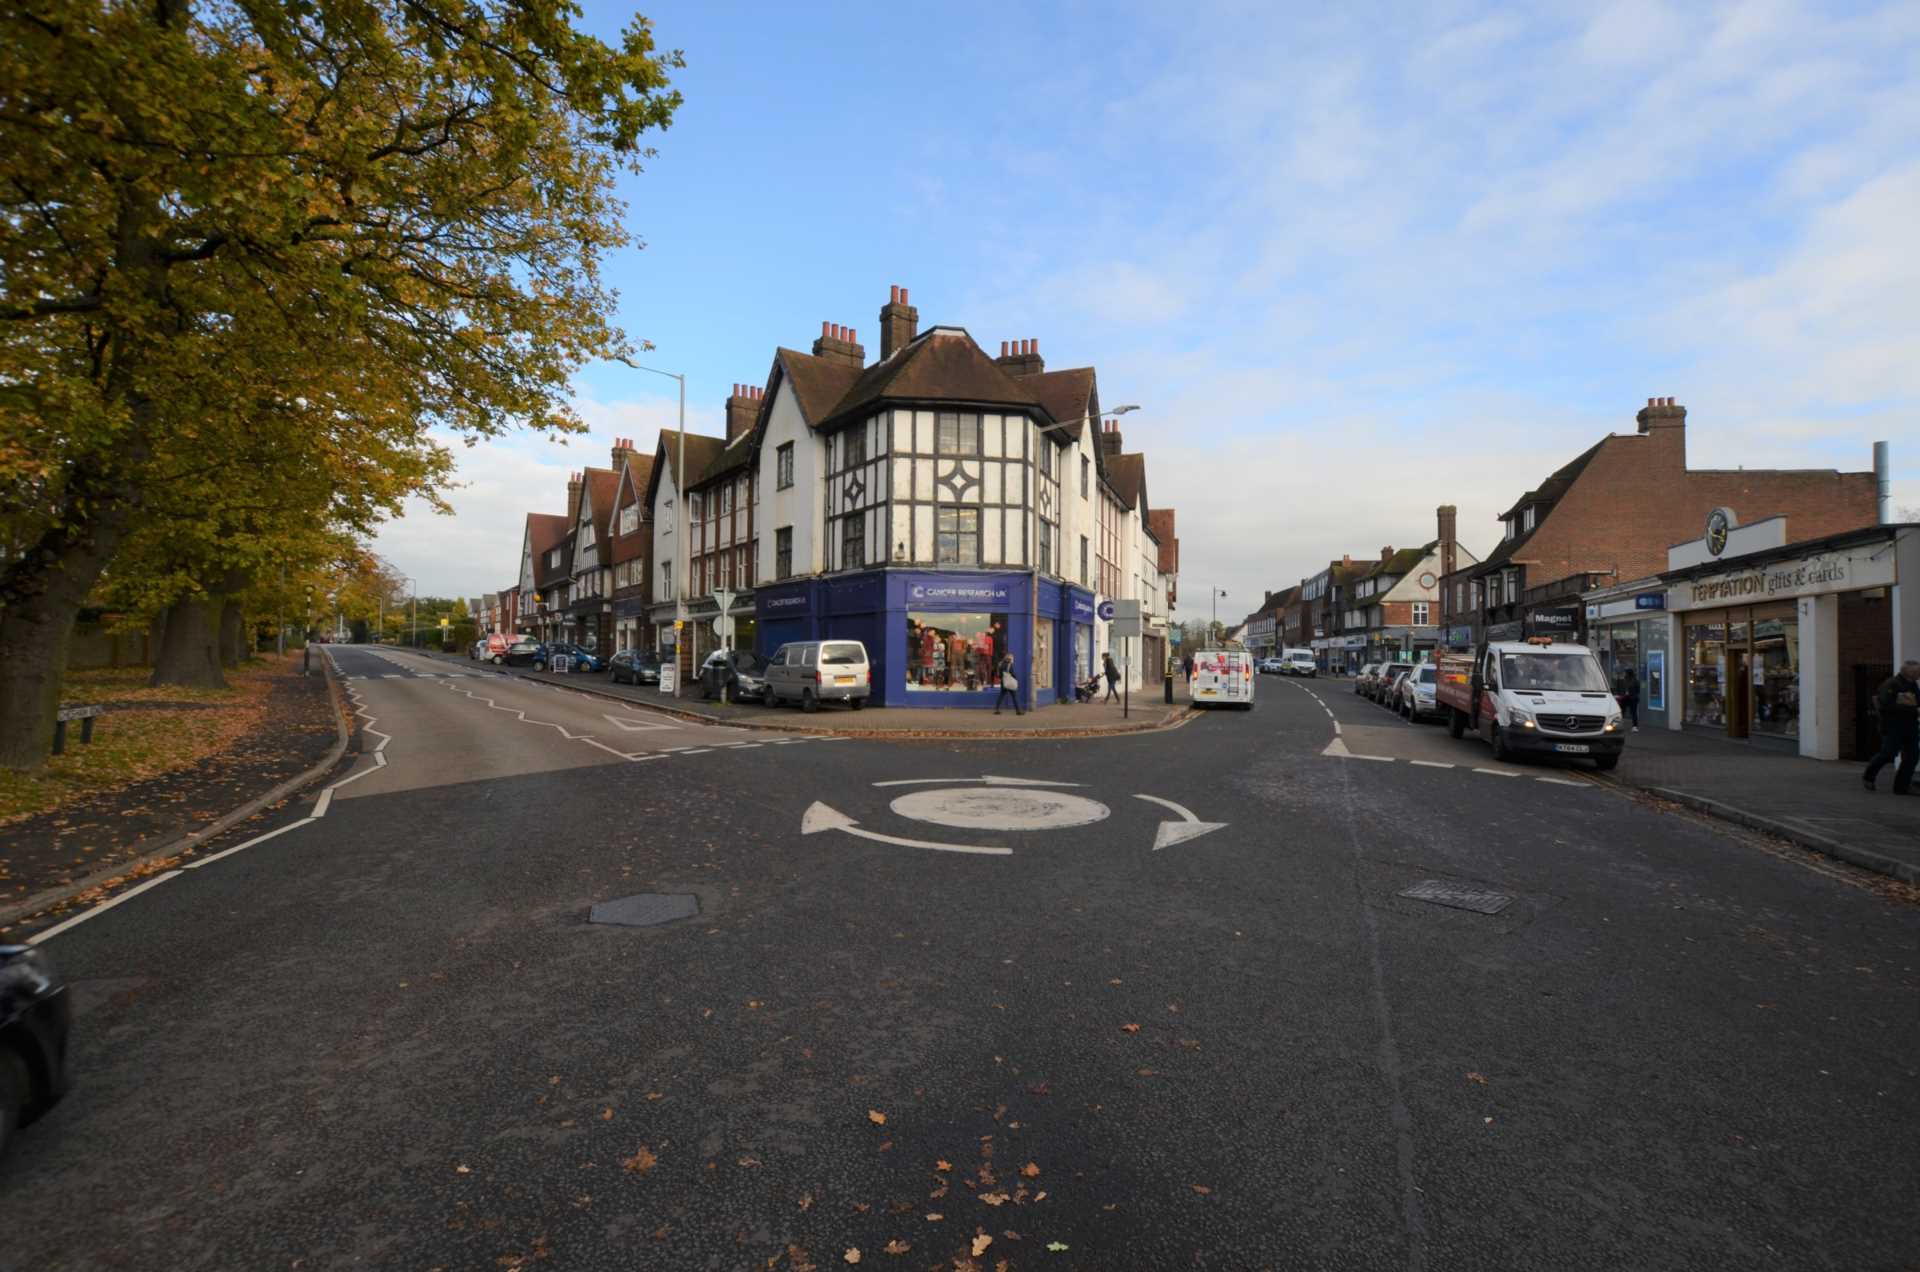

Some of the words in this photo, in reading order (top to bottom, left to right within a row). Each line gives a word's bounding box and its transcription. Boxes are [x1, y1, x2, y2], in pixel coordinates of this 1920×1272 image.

[1692, 575, 1764, 602] TEMPTATION
[1768, 572, 1792, 595] gifts
[1795, 568, 1806, 586] &
[1808, 563, 1846, 584] cards
[1535, 614, 1573, 624] Magnet
